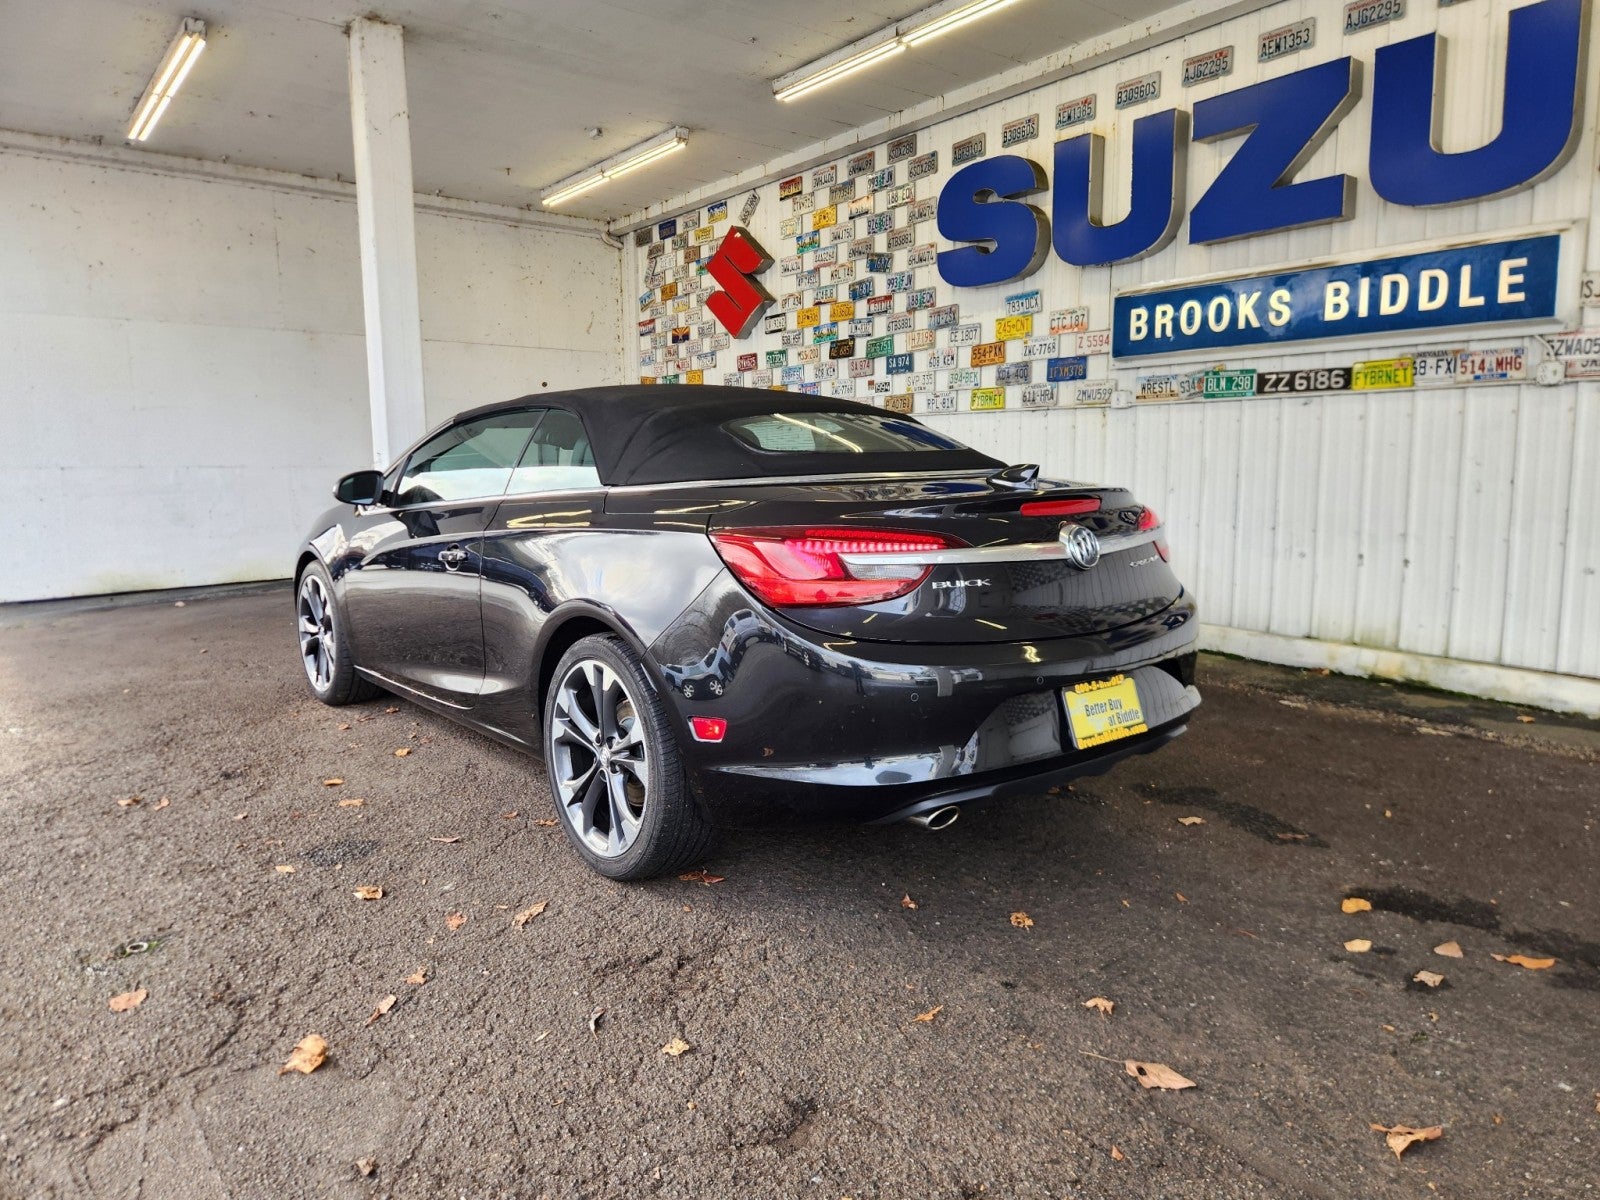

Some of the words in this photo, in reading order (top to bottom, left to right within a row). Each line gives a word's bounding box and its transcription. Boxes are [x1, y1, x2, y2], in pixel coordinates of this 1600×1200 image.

[1260, 28, 1310, 58] AEW1353
[1183, 56, 1229, 83] AJG2295
[1129, 288, 1293, 342] BROOKS
[1323, 256, 1529, 322] BIDDLE
[1460, 358, 1486, 375] 514
[1495, 355, 1522, 372] MHG
[1232, 376, 1251, 391] 298
[1264, 374, 1290, 392] ZZ
[1294, 370, 1345, 390] 6186
[1354, 367, 1409, 386] FYBRNET
[931, 578, 991, 590] BUICK
[1084, 702, 1108, 717] Better
